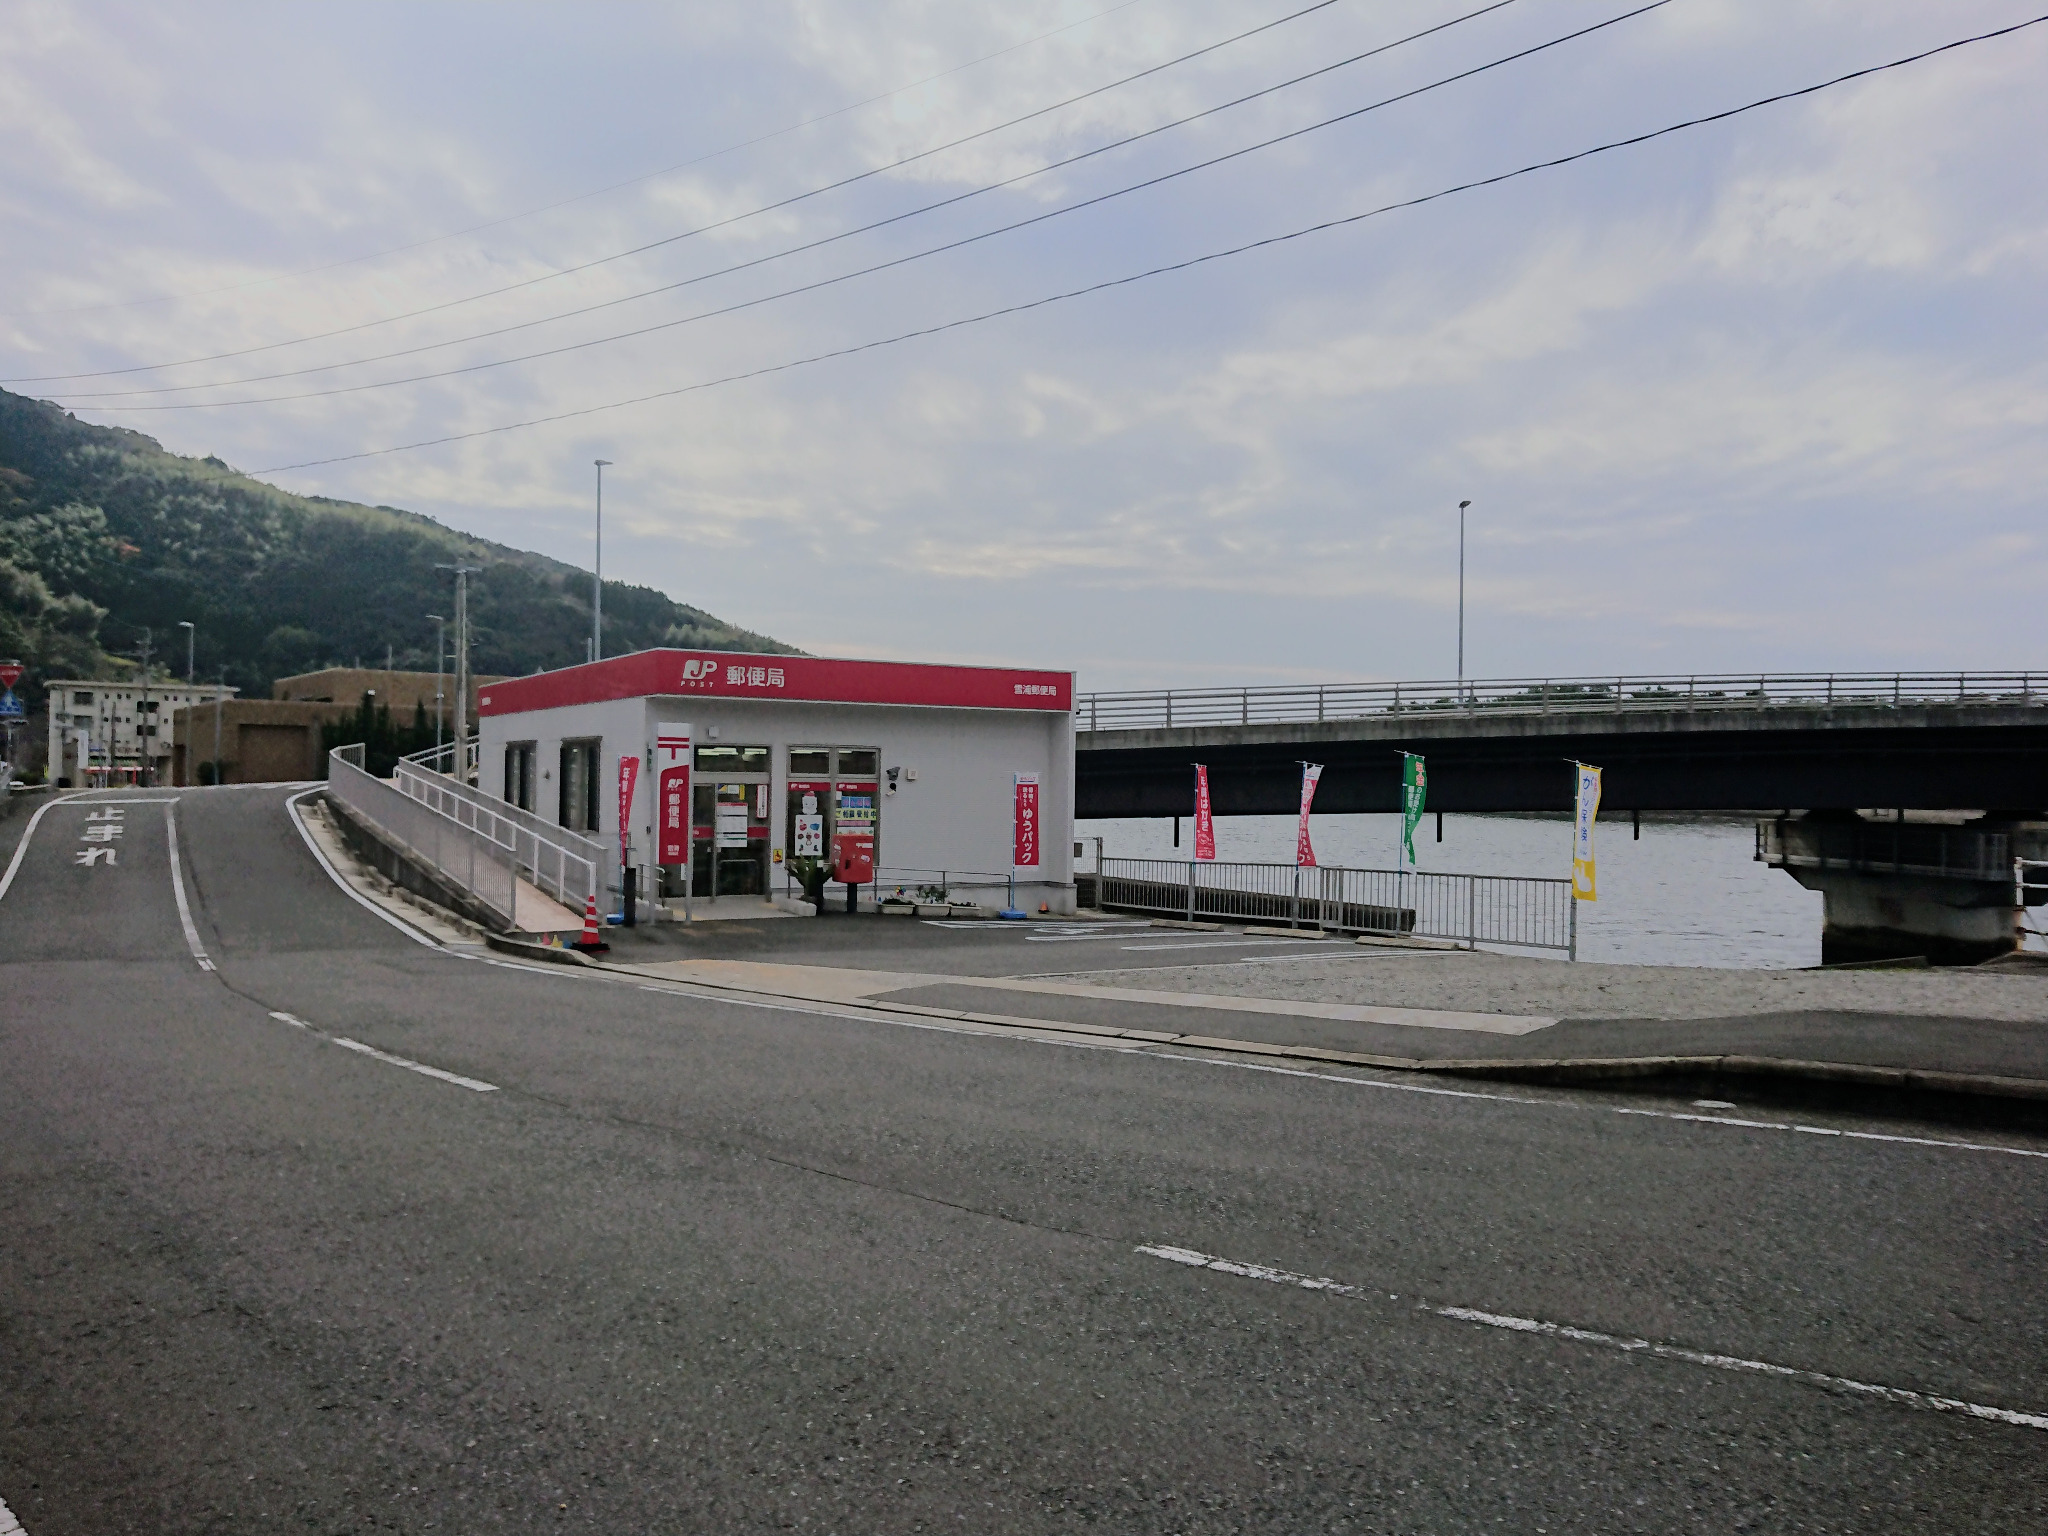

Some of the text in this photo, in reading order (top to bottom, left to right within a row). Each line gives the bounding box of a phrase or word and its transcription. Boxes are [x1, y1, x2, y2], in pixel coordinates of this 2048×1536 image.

[726, 665, 785, 688] 郵便局
[668, 793, 681, 829] 郵便局
[75, 806, 124, 867] 止まれ
[1021, 808, 1034, 863] ゆうパック
